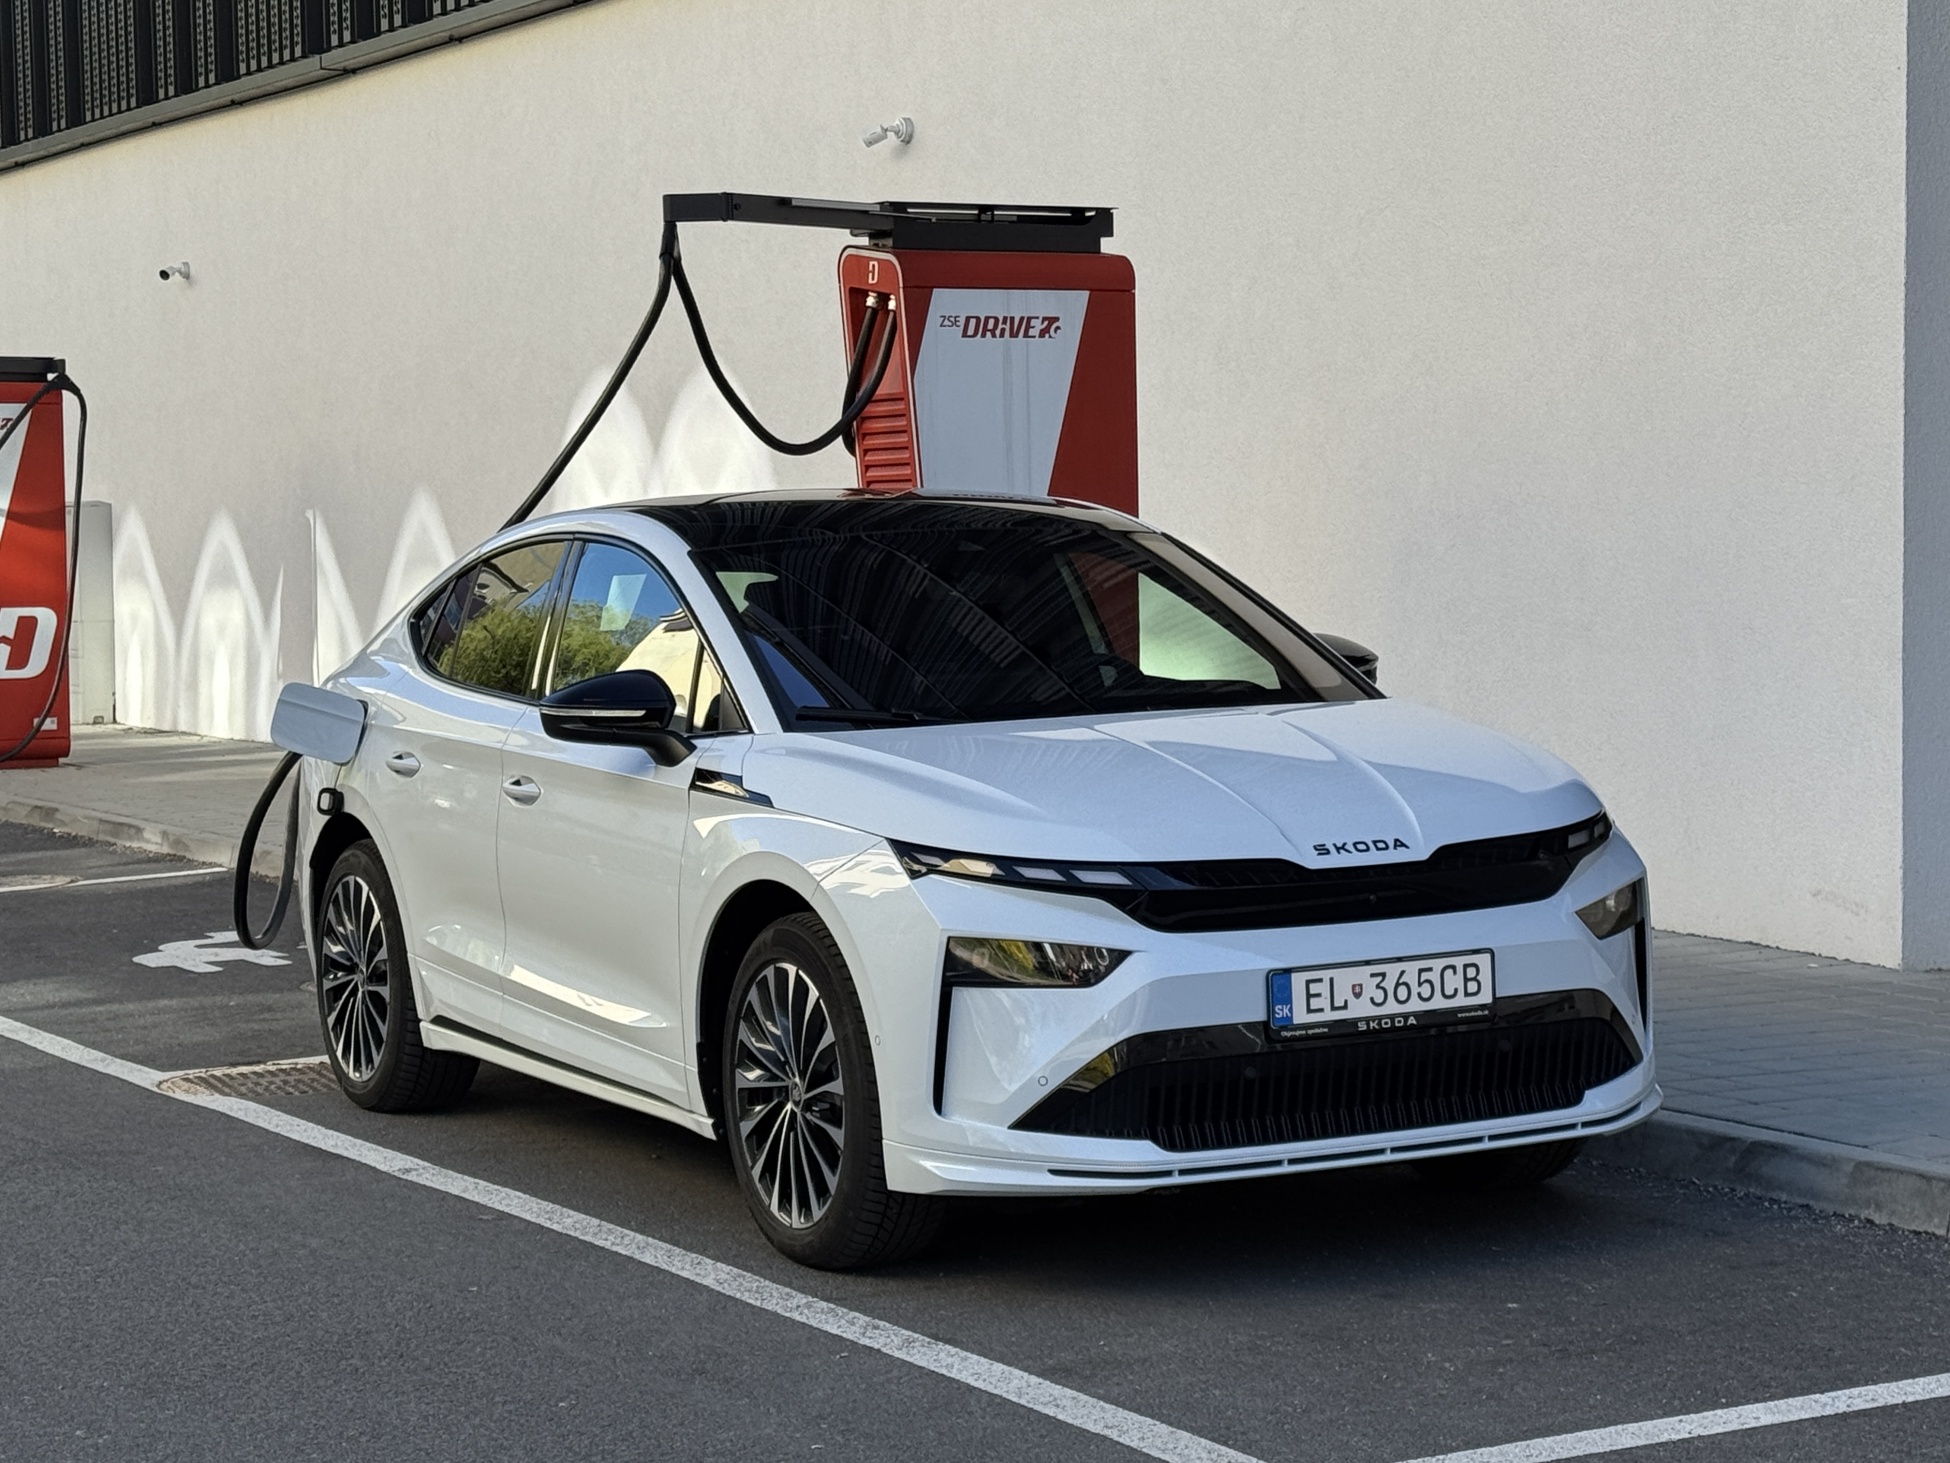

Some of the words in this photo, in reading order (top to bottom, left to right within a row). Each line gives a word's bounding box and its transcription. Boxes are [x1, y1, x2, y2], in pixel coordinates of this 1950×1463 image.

[939, 315, 961, 328] ZSE
[1312, 838, 1411, 856] SKODA
[1305, 976, 1348, 1015] EL
[1369, 962, 1482, 1008] 365CB
[1274, 1004, 1291, 1018] SK
[1357, 1015, 1418, 1031] SKODA
